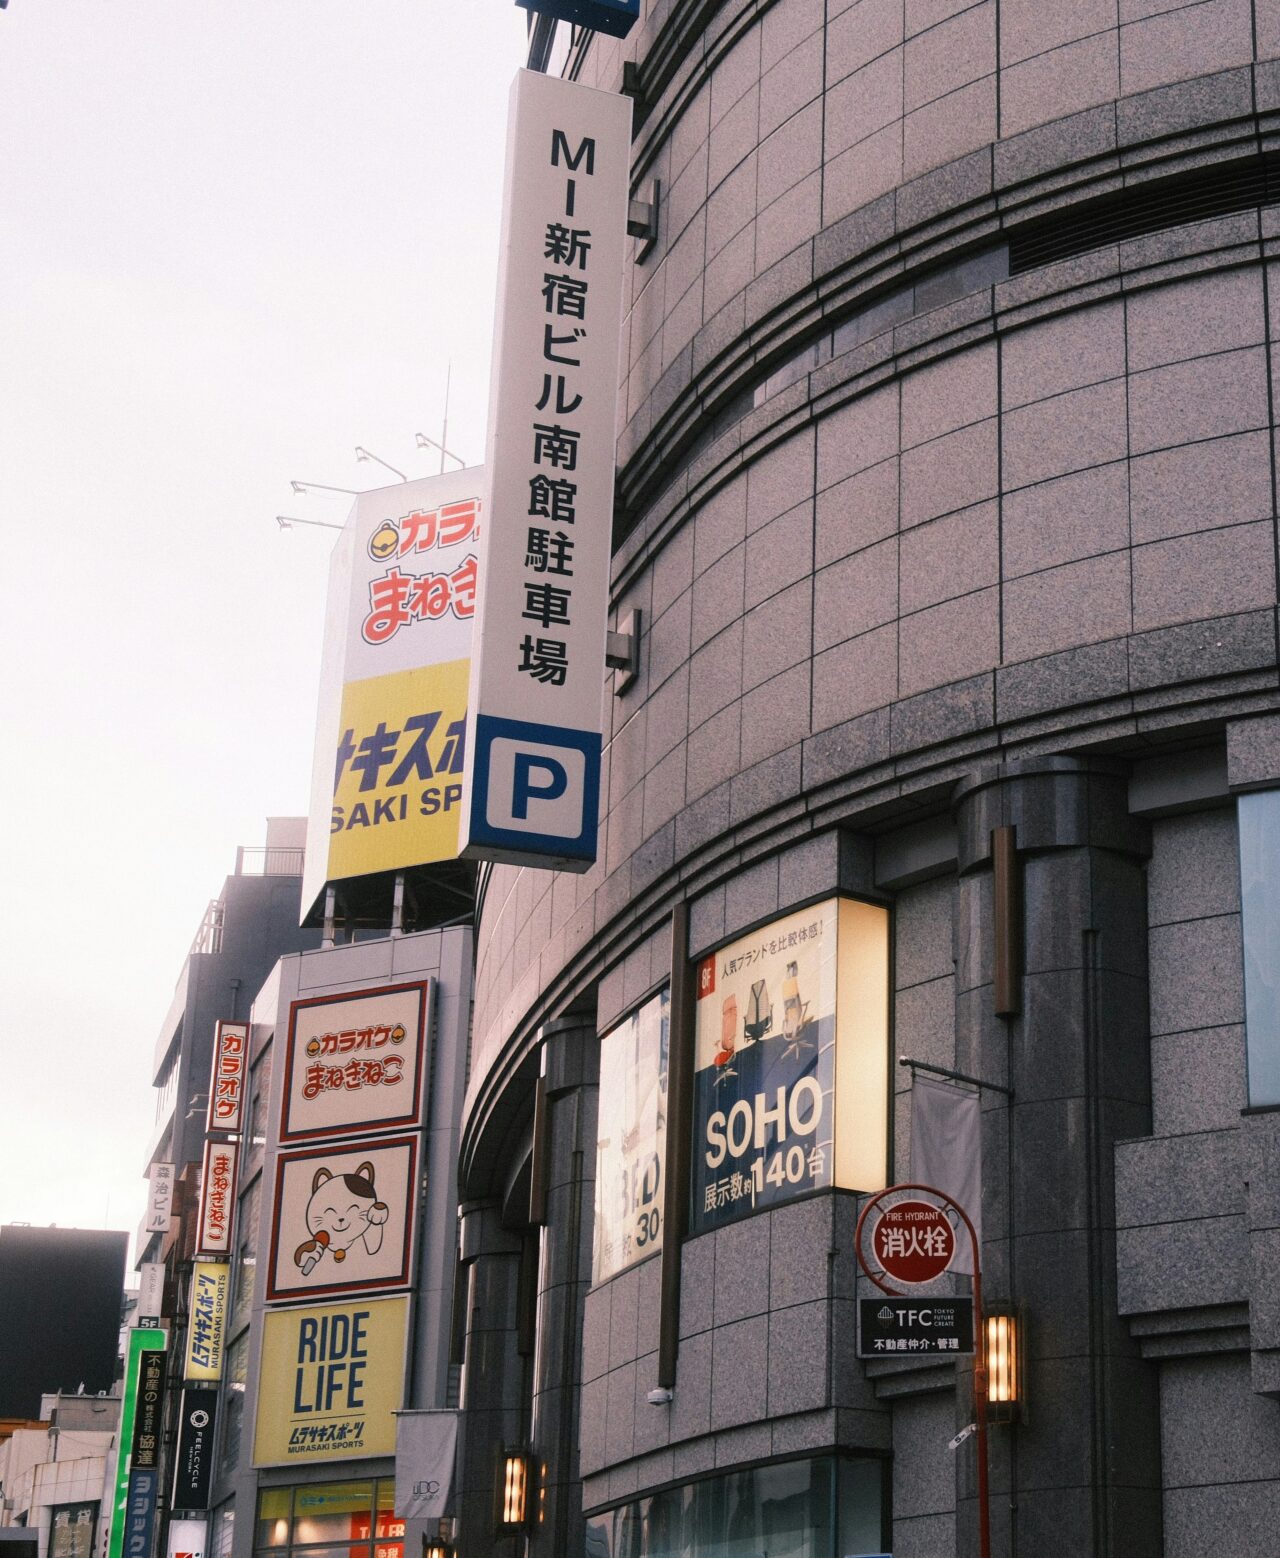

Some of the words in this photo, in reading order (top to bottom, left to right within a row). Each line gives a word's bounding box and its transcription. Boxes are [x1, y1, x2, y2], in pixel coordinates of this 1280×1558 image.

[397, 499, 481, 556] カラ
[511, 752, 569, 820] P
[701, 967, 712, 990] 8F
[320, 1026, 392, 1055] カラオケ
[216, 1034, 244, 1118] カラオケ
[303, 1055, 405, 1100] まねきねこ
[705, 1076, 823, 1169] SOHO
[208, 1154, 230, 1241] まねきねこ
[886, 1212, 903, 1222] FIRE
[905, 1211, 939, 1222] HYDRANT
[880, 1226, 949, 1259] 消火栓
[216, 1274, 226, 1314] SPORTS
[896, 1309, 932, 1327] TFC
[140, 1318, 157, 1329] 5F
[191, 1274, 216, 1369] ムラサキスポーツ
[211, 1314, 223, 1369] MURASAKI
[298, 1311, 370, 1364] RIDE
[874, 1337, 960, 1351] 不動産仲介・管理
[294, 1361, 366, 1414] LIFE
[288, 1421, 365, 1445] ムラサキスポーツ
[288, 1442, 330, 1454] MURASAKI
[332, 1440, 364, 1450] SPORTS
[191, 1431, 203, 1489] FEELCYCLE
[129, 1476, 151, 1558] ヨシック
